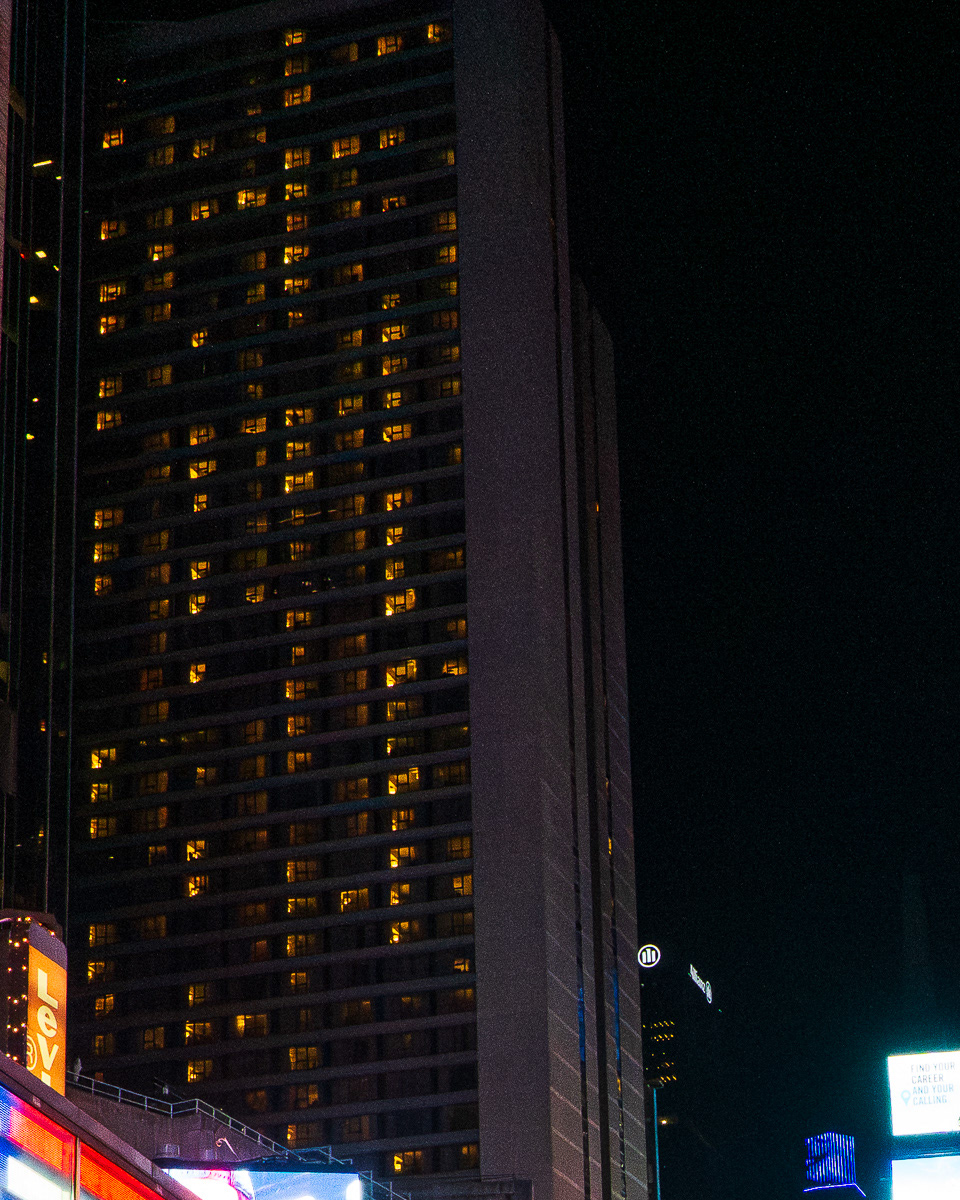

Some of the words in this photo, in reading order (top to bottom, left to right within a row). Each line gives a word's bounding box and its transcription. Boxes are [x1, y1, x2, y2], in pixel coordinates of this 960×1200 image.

[933, 1062, 955, 1071] YOUR
[912, 1074, 944, 1084] CAREER
[913, 1085, 929, 1094] AND
[932, 1083, 954, 1093] YOUR
[913, 1095, 947, 1105] CALLING
